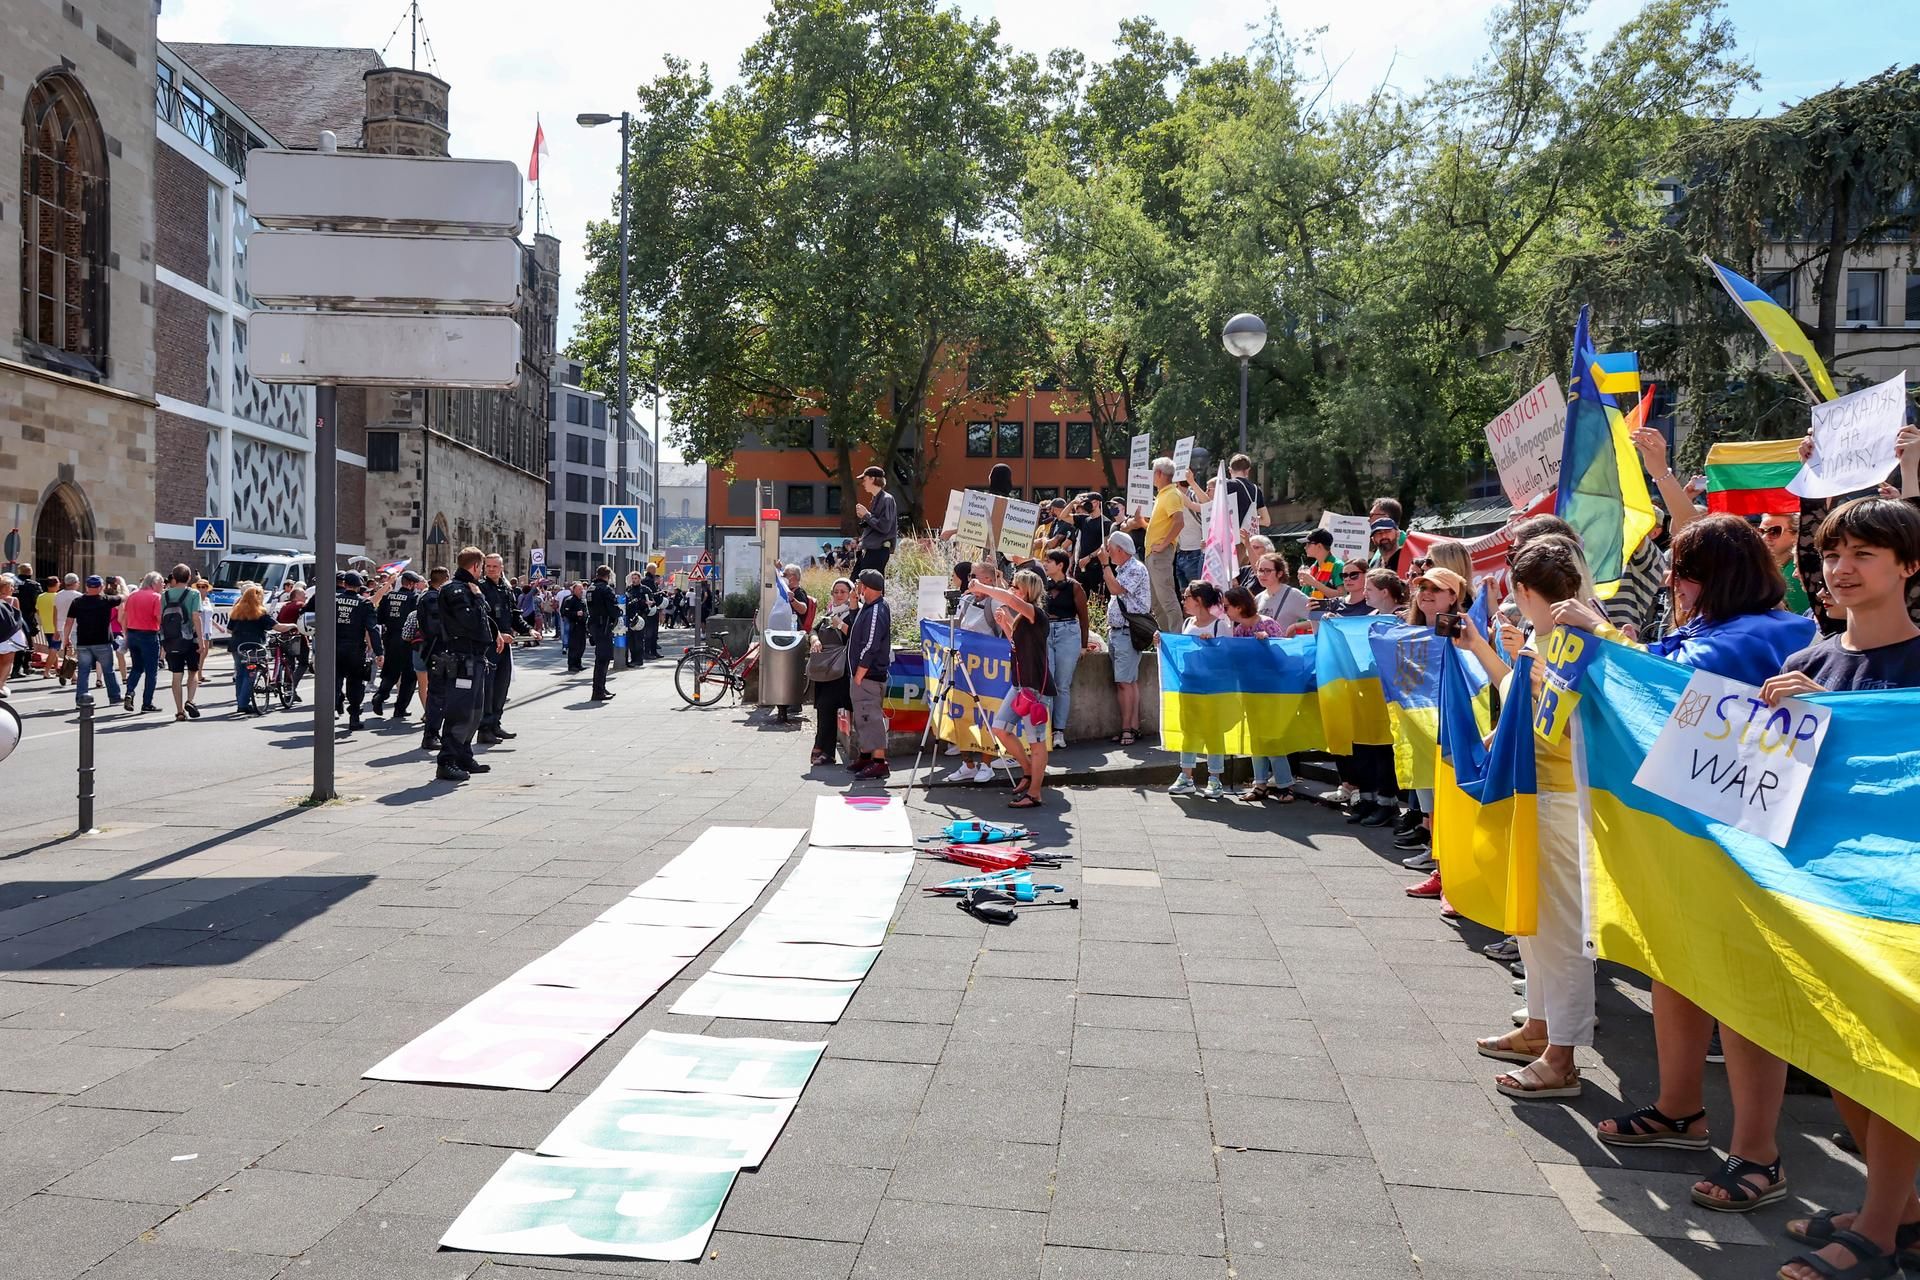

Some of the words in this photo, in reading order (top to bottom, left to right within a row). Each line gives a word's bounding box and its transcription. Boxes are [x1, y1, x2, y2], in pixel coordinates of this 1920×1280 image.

[1489, 385, 1549, 443] VORSICHT
[967, 653, 1012, 683] PUT
[1547, 627, 1585, 670] OP
[1704, 694, 1818, 758] STOP
[1691, 748, 1779, 812] WAR
